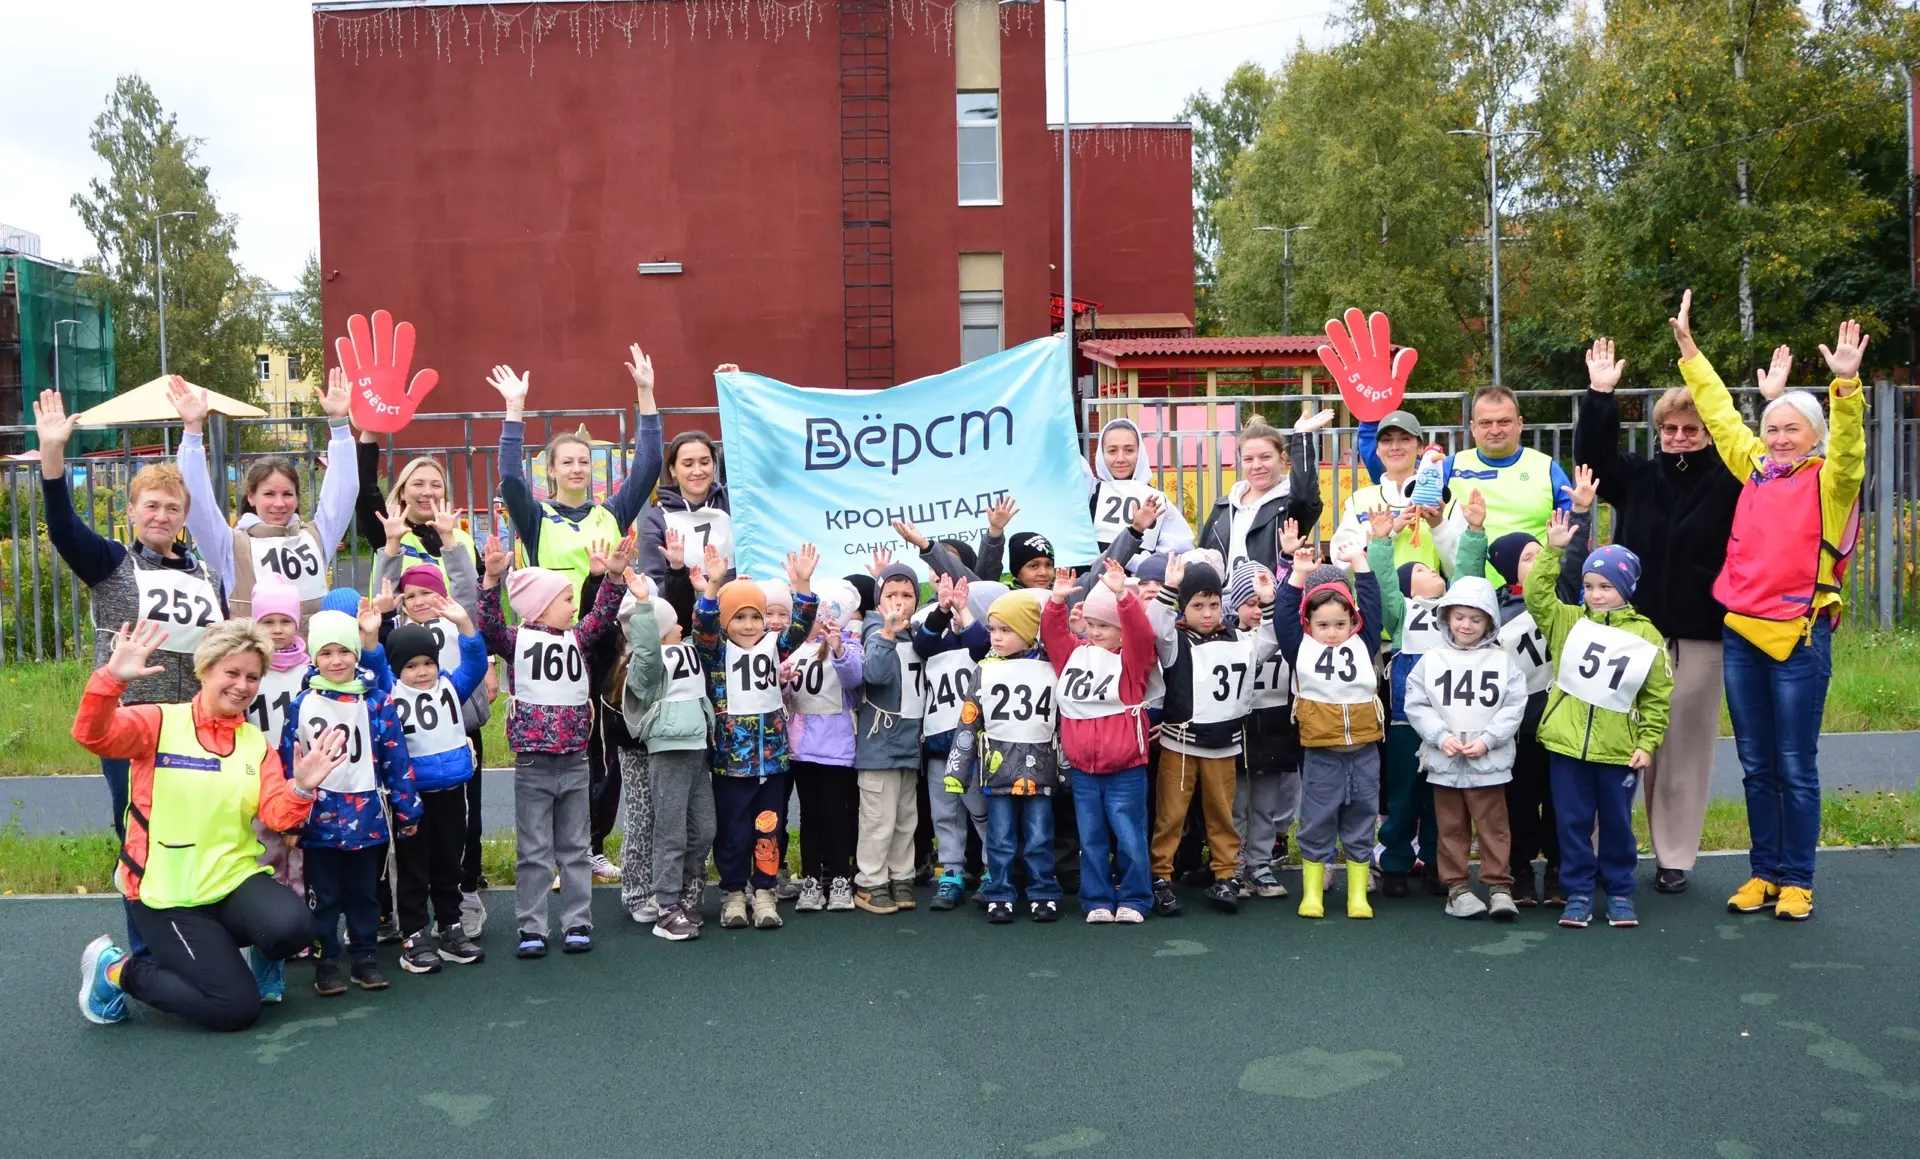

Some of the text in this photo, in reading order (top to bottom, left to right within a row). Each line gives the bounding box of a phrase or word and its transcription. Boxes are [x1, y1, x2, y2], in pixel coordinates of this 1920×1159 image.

[358, 376, 401, 415] 5 вёрст
[1348, 373, 1393, 402] 5 вёрст
[260, 543, 318, 580] 165
[147, 588, 213, 627] 252
[523, 642, 582, 682] 160
[1212, 662, 1247, 701] 37
[1315, 647, 1357, 682] 43
[1578, 642, 1630, 691] 51
[927, 668, 973, 715] 240
[990, 684, 1051, 723] 234
[1434, 670, 1500, 708] 145
[249, 690, 302, 732] 11
[396, 687, 459, 735] 261
